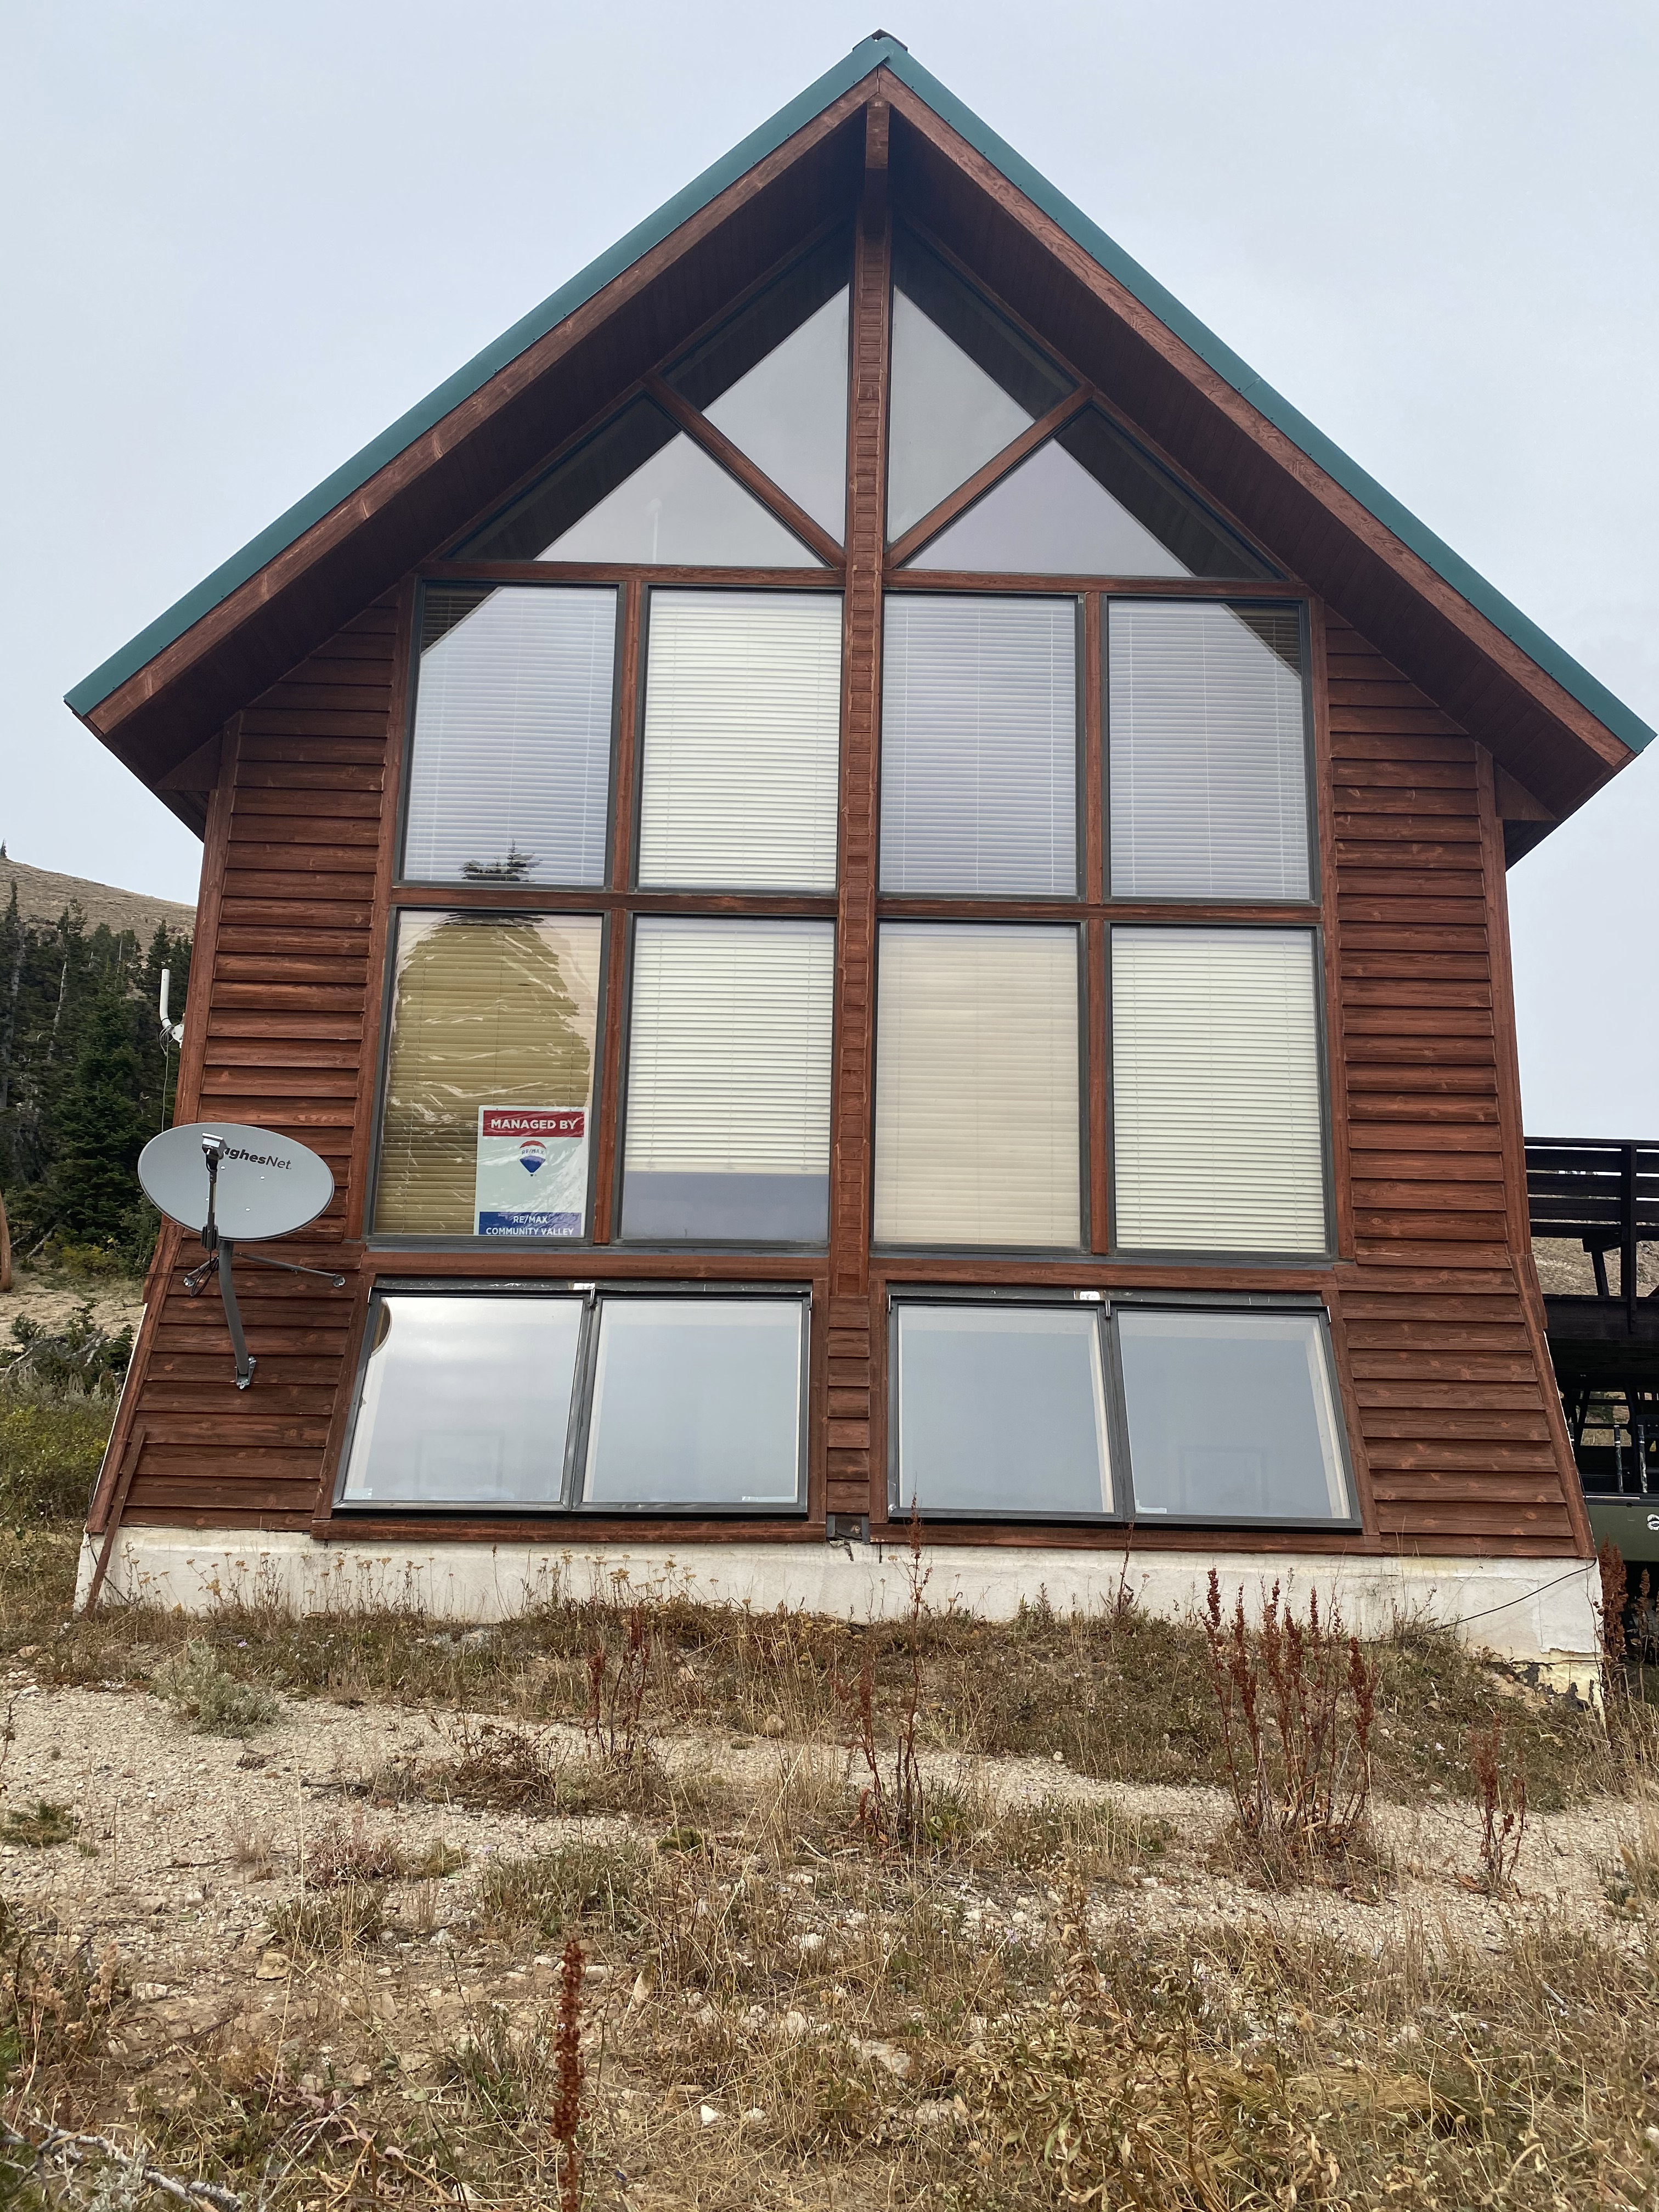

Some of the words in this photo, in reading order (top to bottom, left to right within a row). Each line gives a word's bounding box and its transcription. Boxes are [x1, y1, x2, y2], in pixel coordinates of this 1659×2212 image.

[491, 1119, 556, 1129] MANAGED
[560, 1120, 577, 1130] BY
[513, 1215, 548, 1224] RE/MAX
